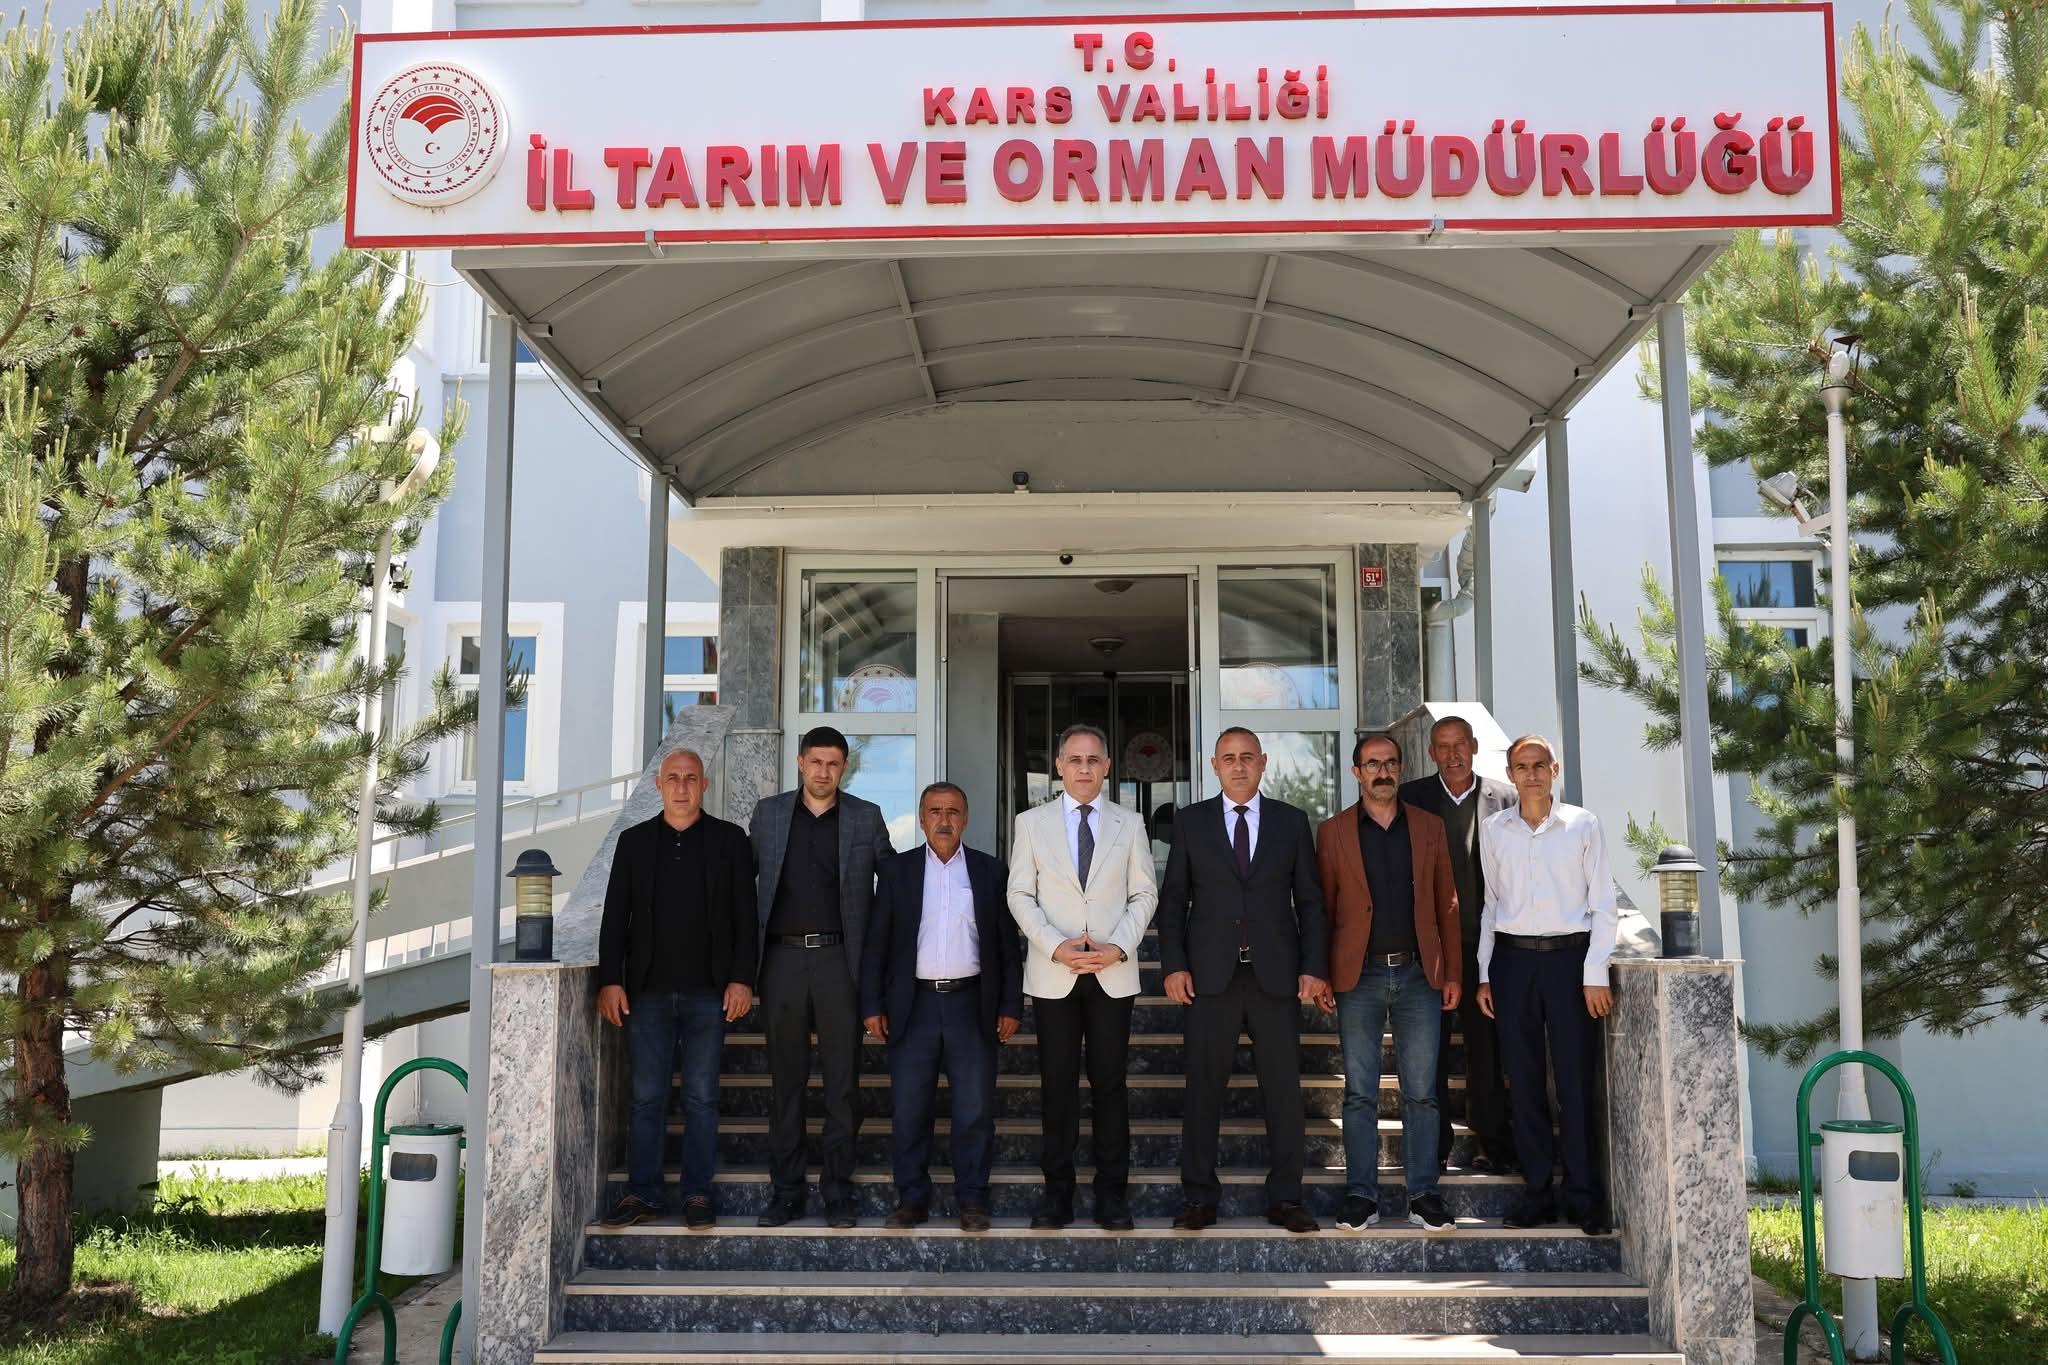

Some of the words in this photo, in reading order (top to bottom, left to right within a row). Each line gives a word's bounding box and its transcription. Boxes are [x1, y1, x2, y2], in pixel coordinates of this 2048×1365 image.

[1073, 31, 1177, 73] T.C.
[424, 85, 451, 93] TARIM
[453, 91, 463, 100] VE
[463, 99, 478, 128] ORMAN
[923, 85, 1073, 126] KARS
[1097, 64, 1330, 122] VALİLİĞİ
[526, 133, 595, 212] İL
[603, 141, 843, 211] TARIM
[866, 140, 967, 204] VE
[993, 136, 1285, 203] ORMAN
[1311, 111, 1815, 201] MÜDÜRLÜĞÜ
